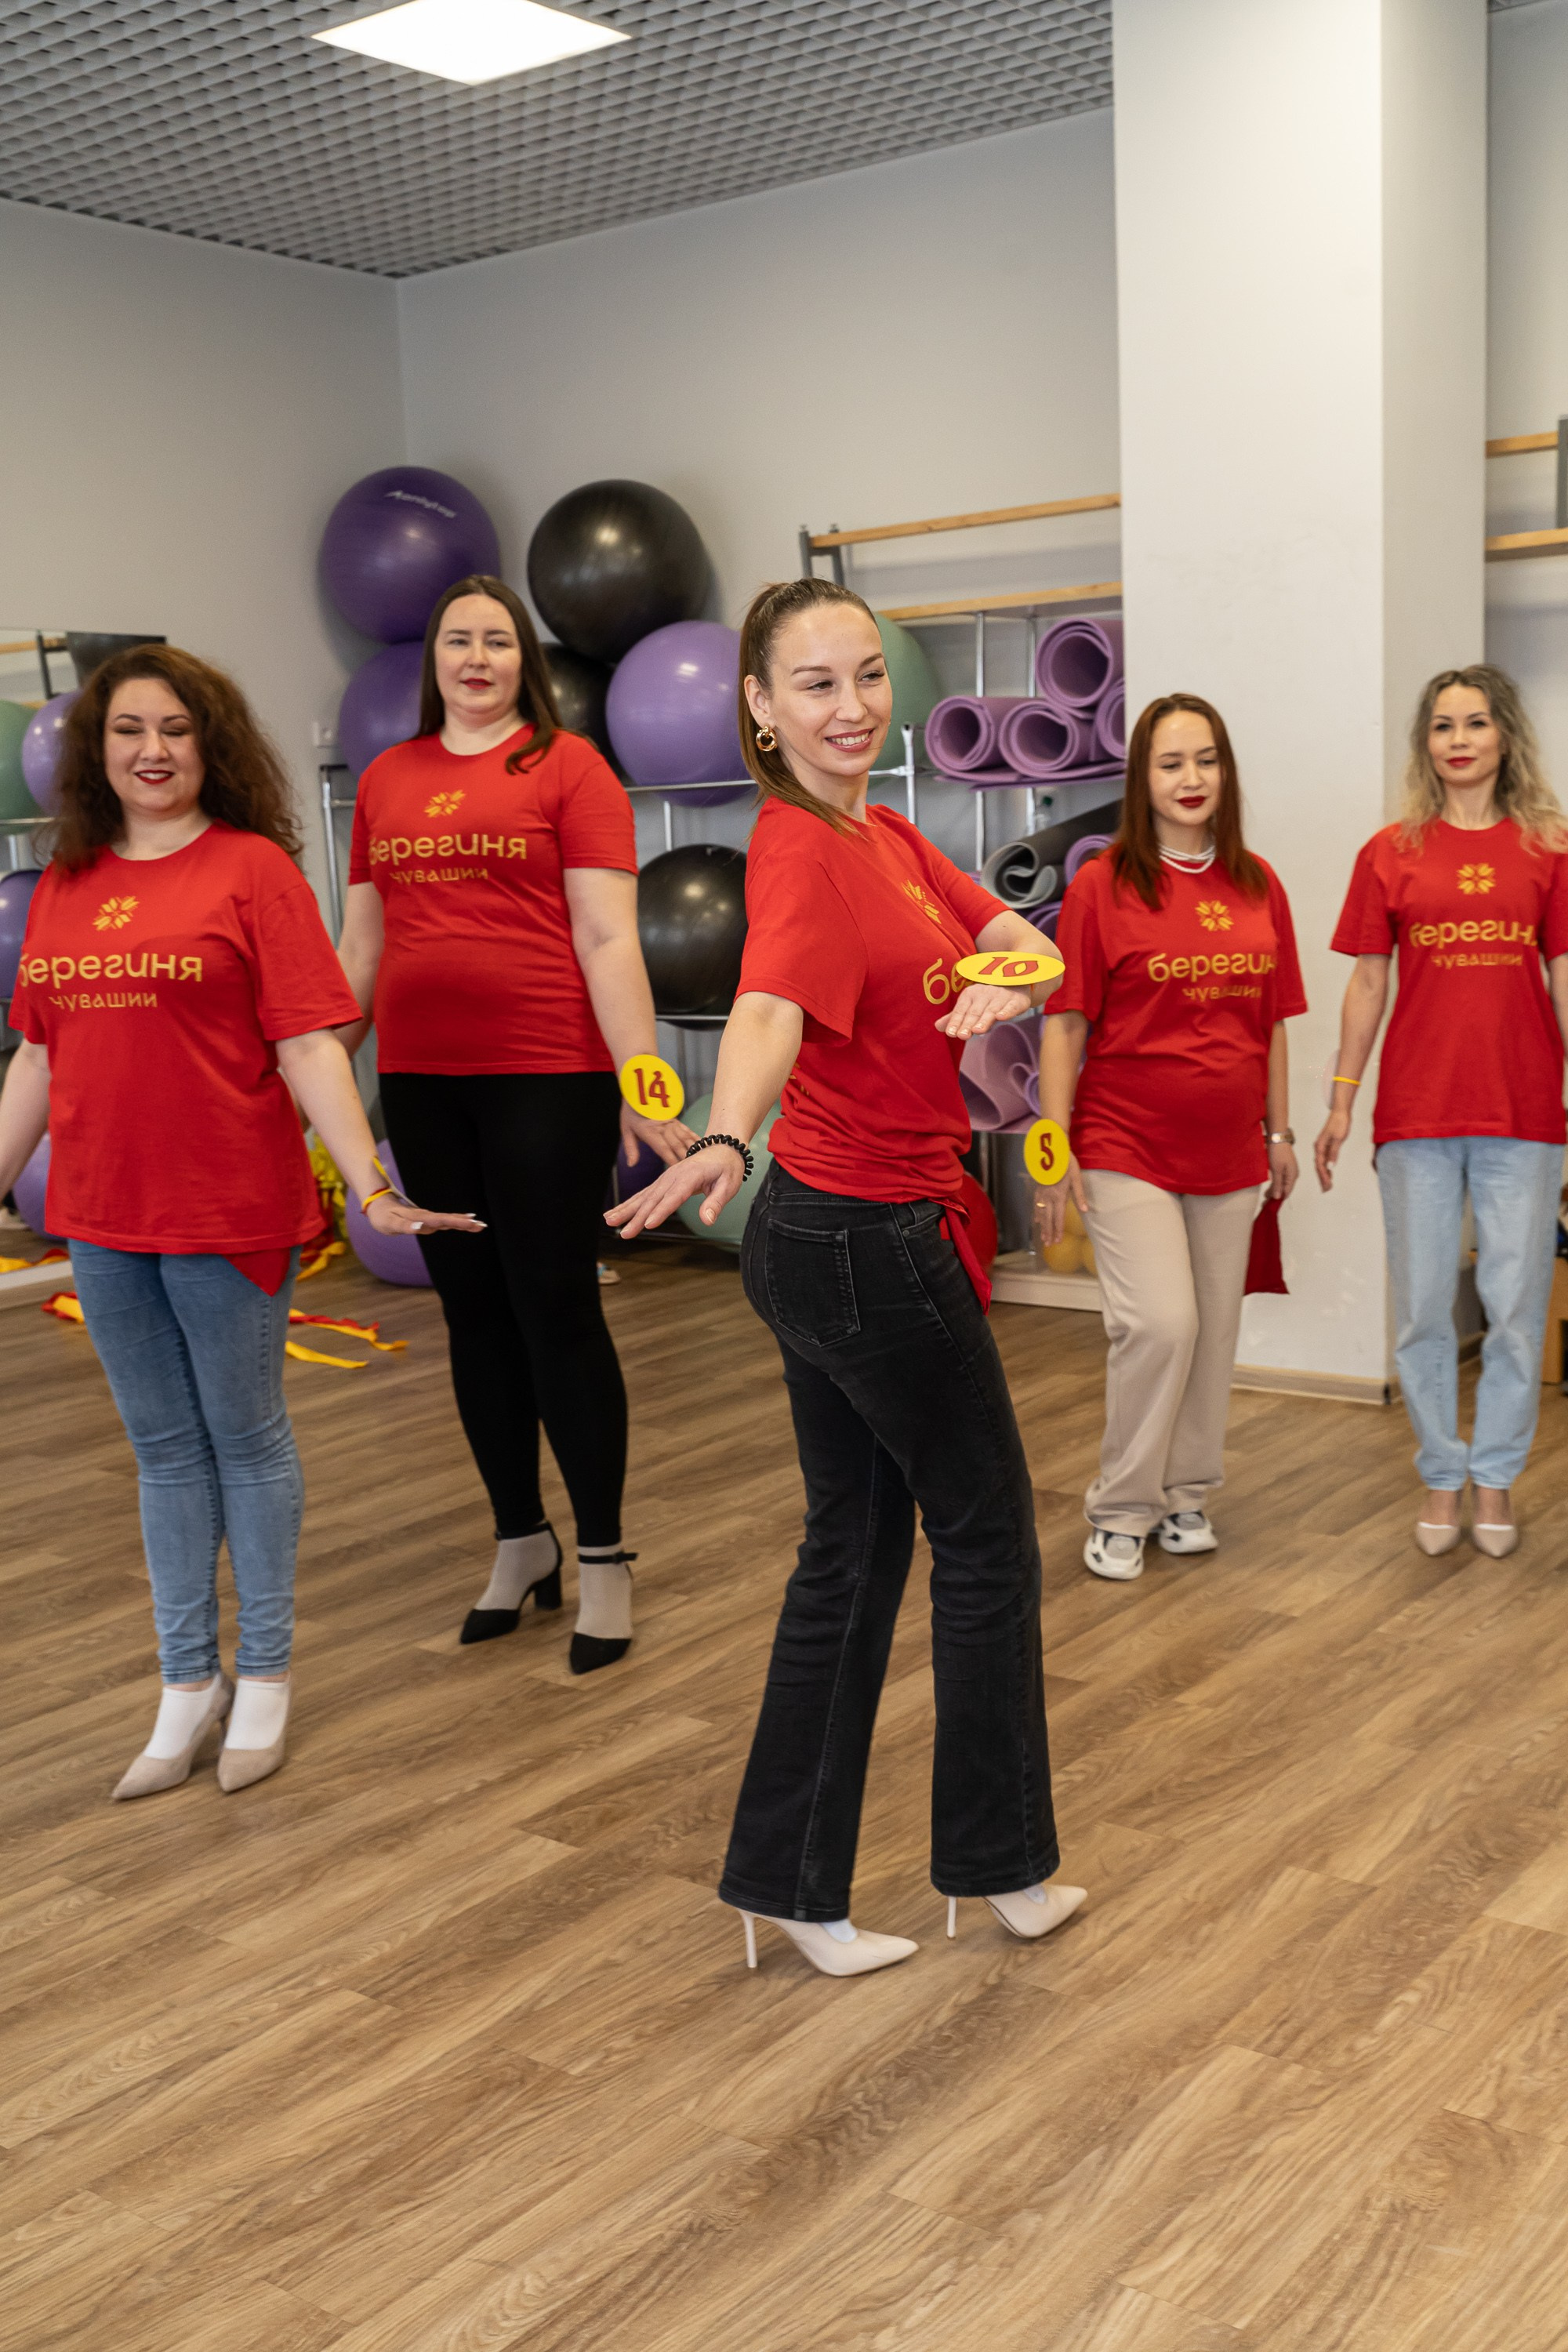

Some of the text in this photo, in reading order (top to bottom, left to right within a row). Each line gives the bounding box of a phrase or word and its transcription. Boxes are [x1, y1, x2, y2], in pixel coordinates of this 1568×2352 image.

[978, 956, 1040, 978] 10
[1147, 952, 1276, 982] берегин
[49, 992, 158, 1012] чувашии
[633, 1067, 670, 1108] 14
